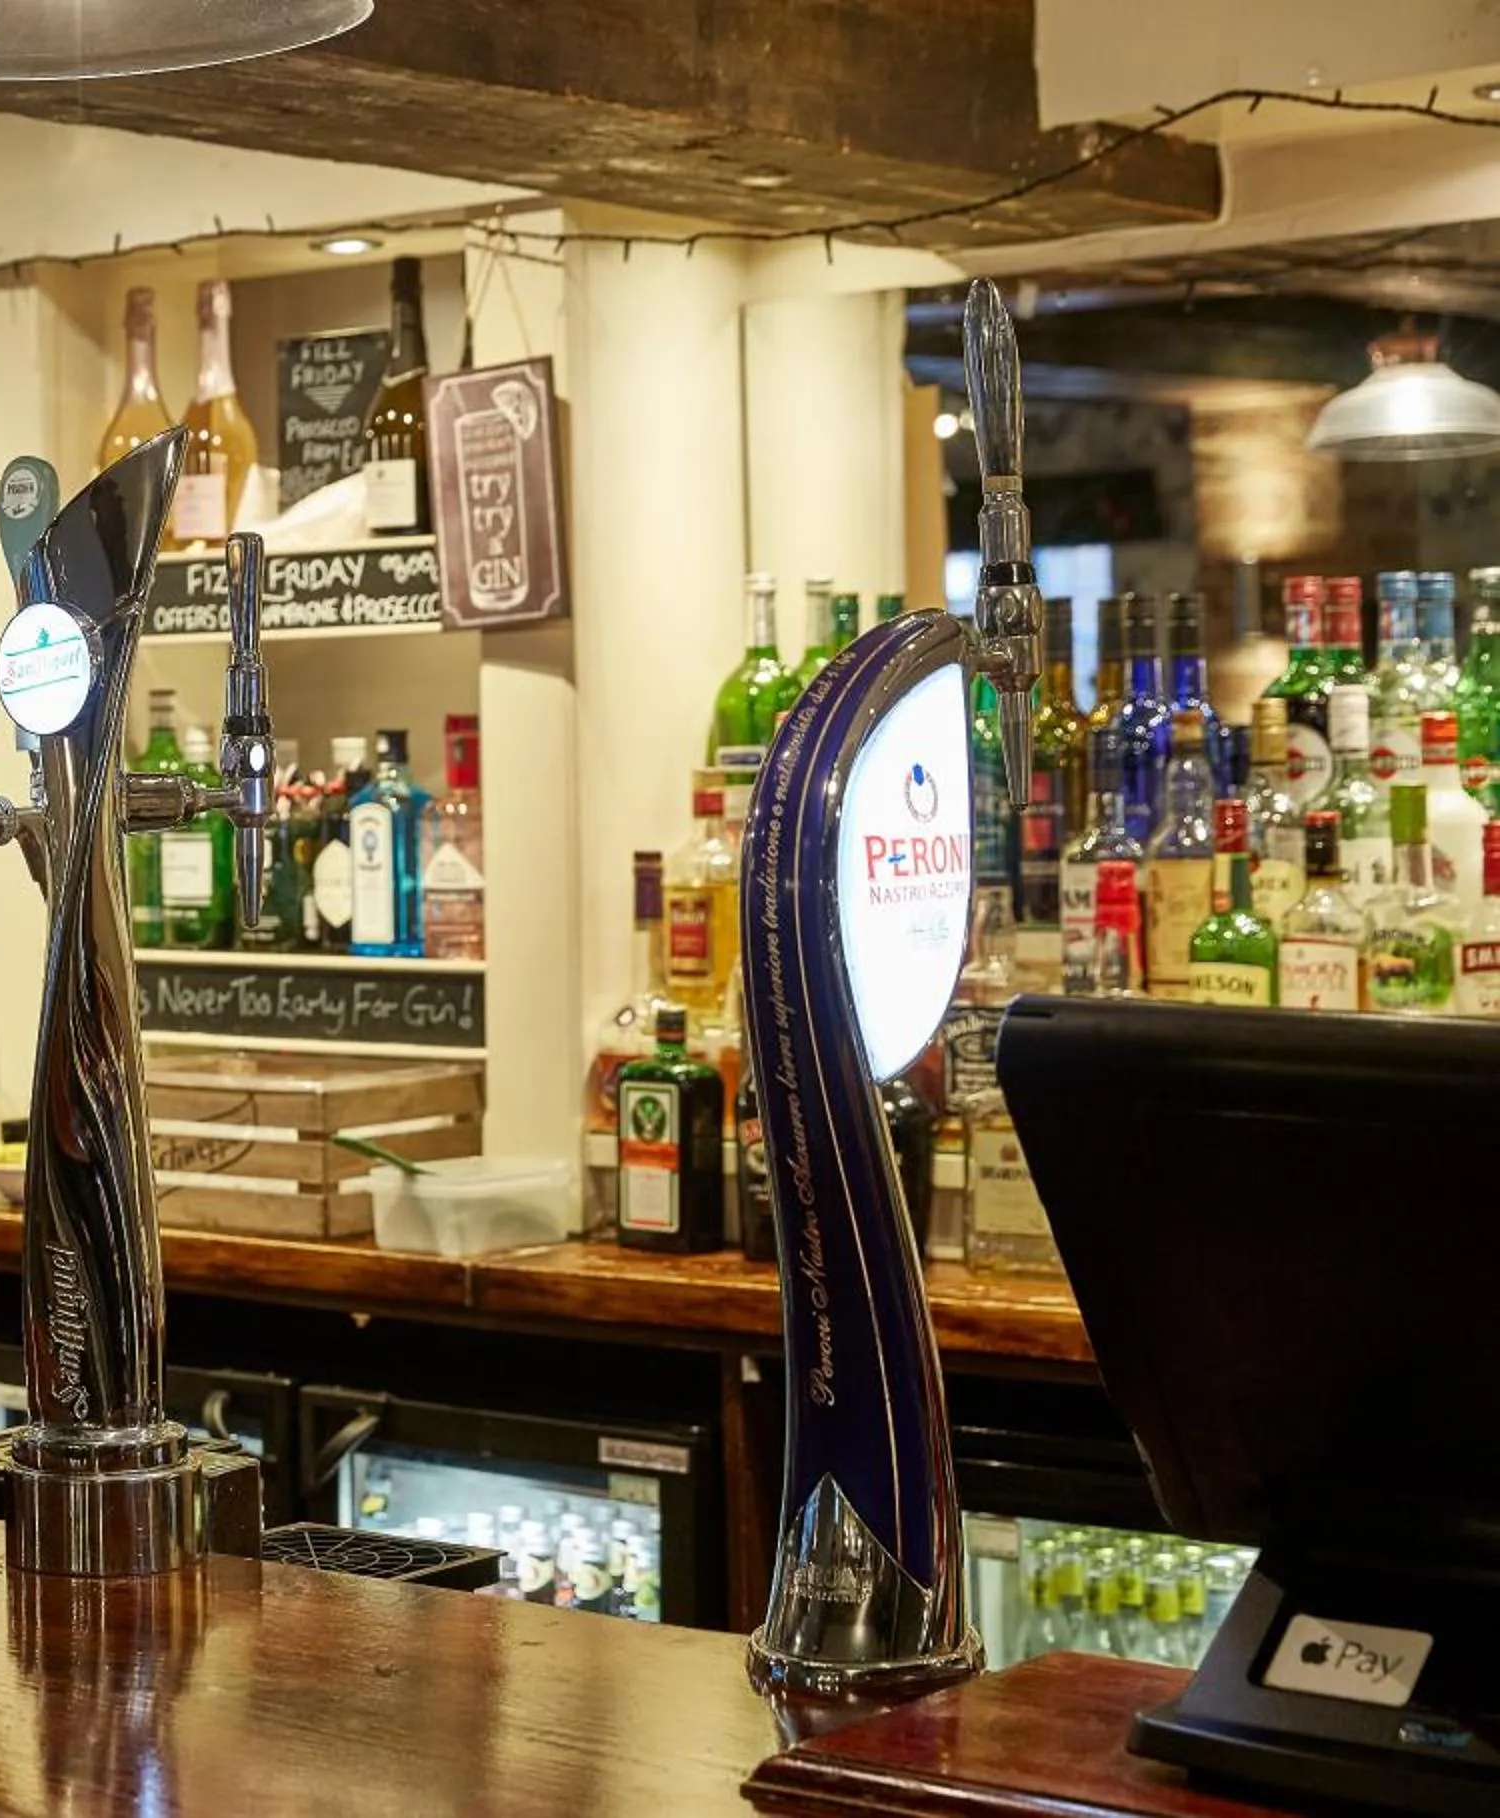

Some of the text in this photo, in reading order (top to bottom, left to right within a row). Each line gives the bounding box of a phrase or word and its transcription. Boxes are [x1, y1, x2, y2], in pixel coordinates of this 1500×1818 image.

[291, 360, 365, 388] FRIDAY
[187, 553, 366, 596] FIZ FRIDAY
[476, 555, 522, 589] GIN
[153, 604, 217, 632] OFFERS
[157, 975, 234, 1016] Never
[230, 974, 272, 1018] Too
[277, 976, 346, 1035] Early
[353, 982, 399, 1026] For
[403, 984, 474, 1030] Gin!
[1333, 1639, 1405, 1684] Pay
